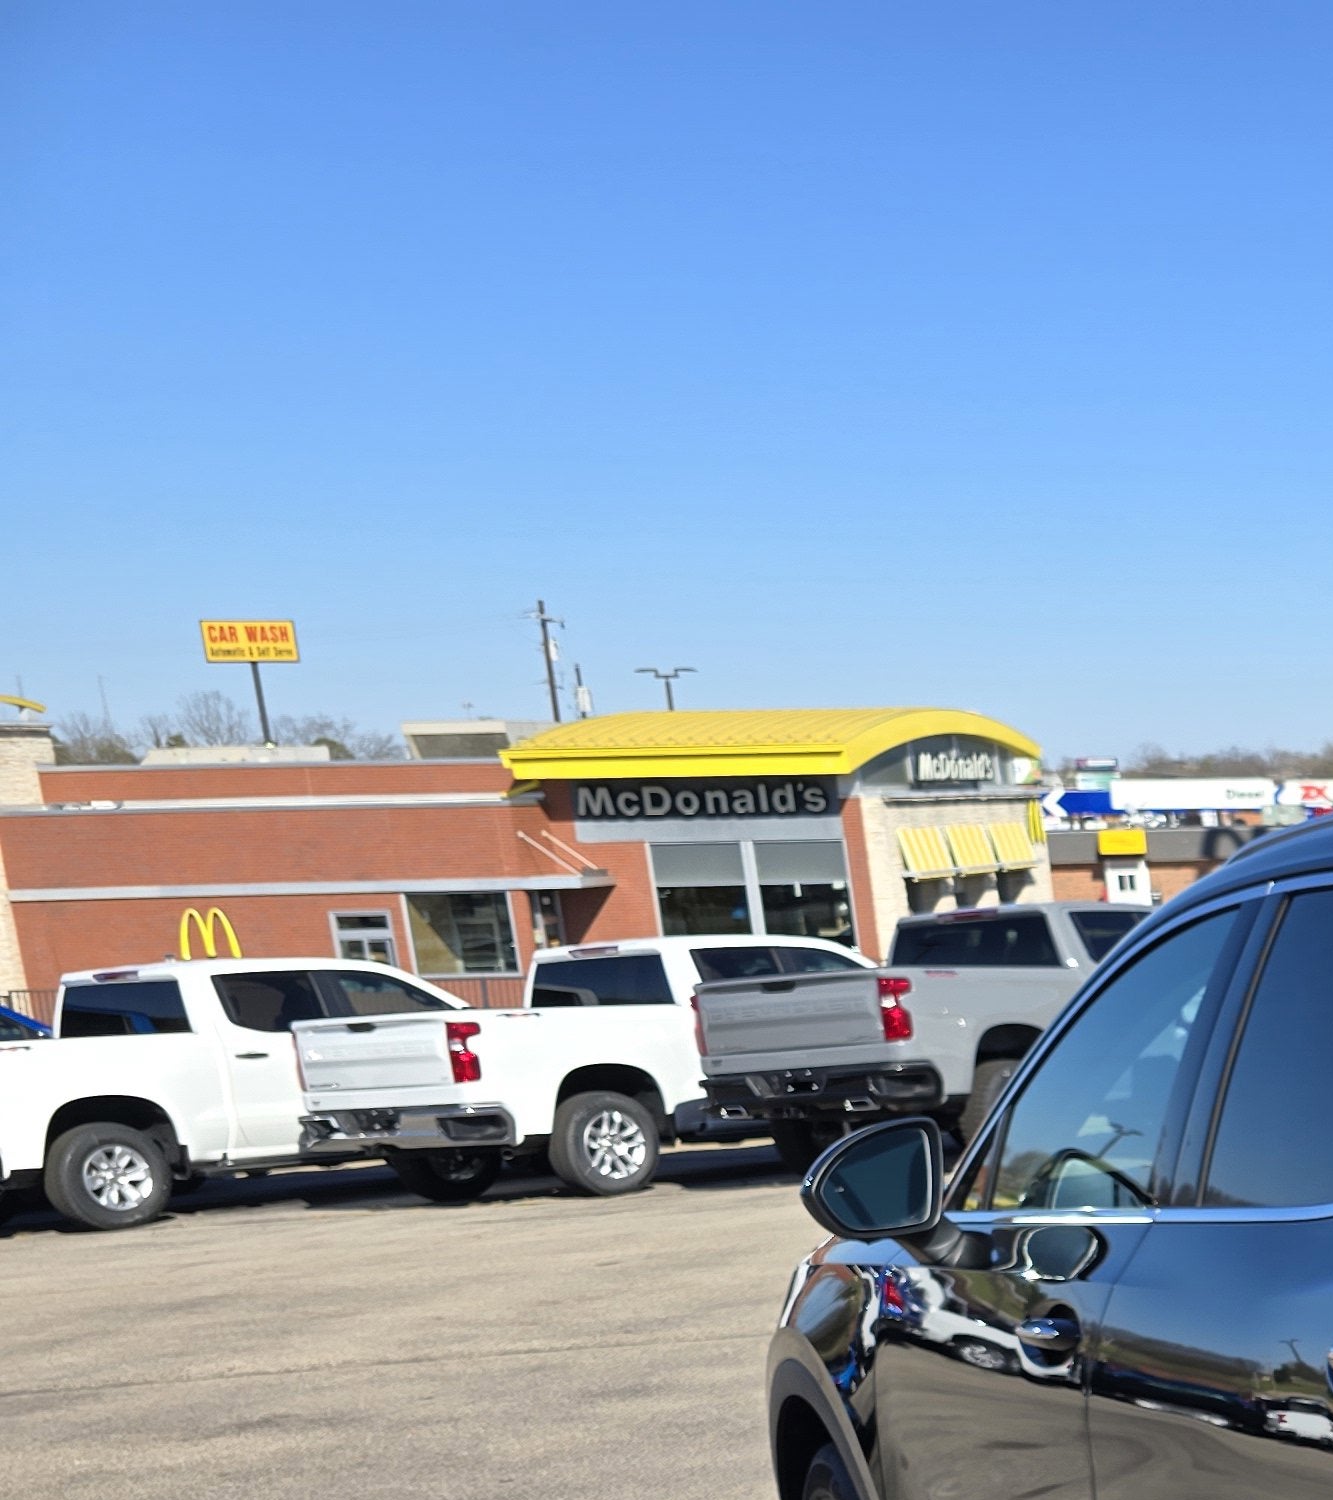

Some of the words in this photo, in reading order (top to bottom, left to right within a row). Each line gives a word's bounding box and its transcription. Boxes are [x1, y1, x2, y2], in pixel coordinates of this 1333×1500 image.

[207, 625, 239, 643] CAR
[244, 625, 290, 643] WASH
[917, 749, 994, 782] McDonald's
[576, 781, 827, 818] McDonald's
